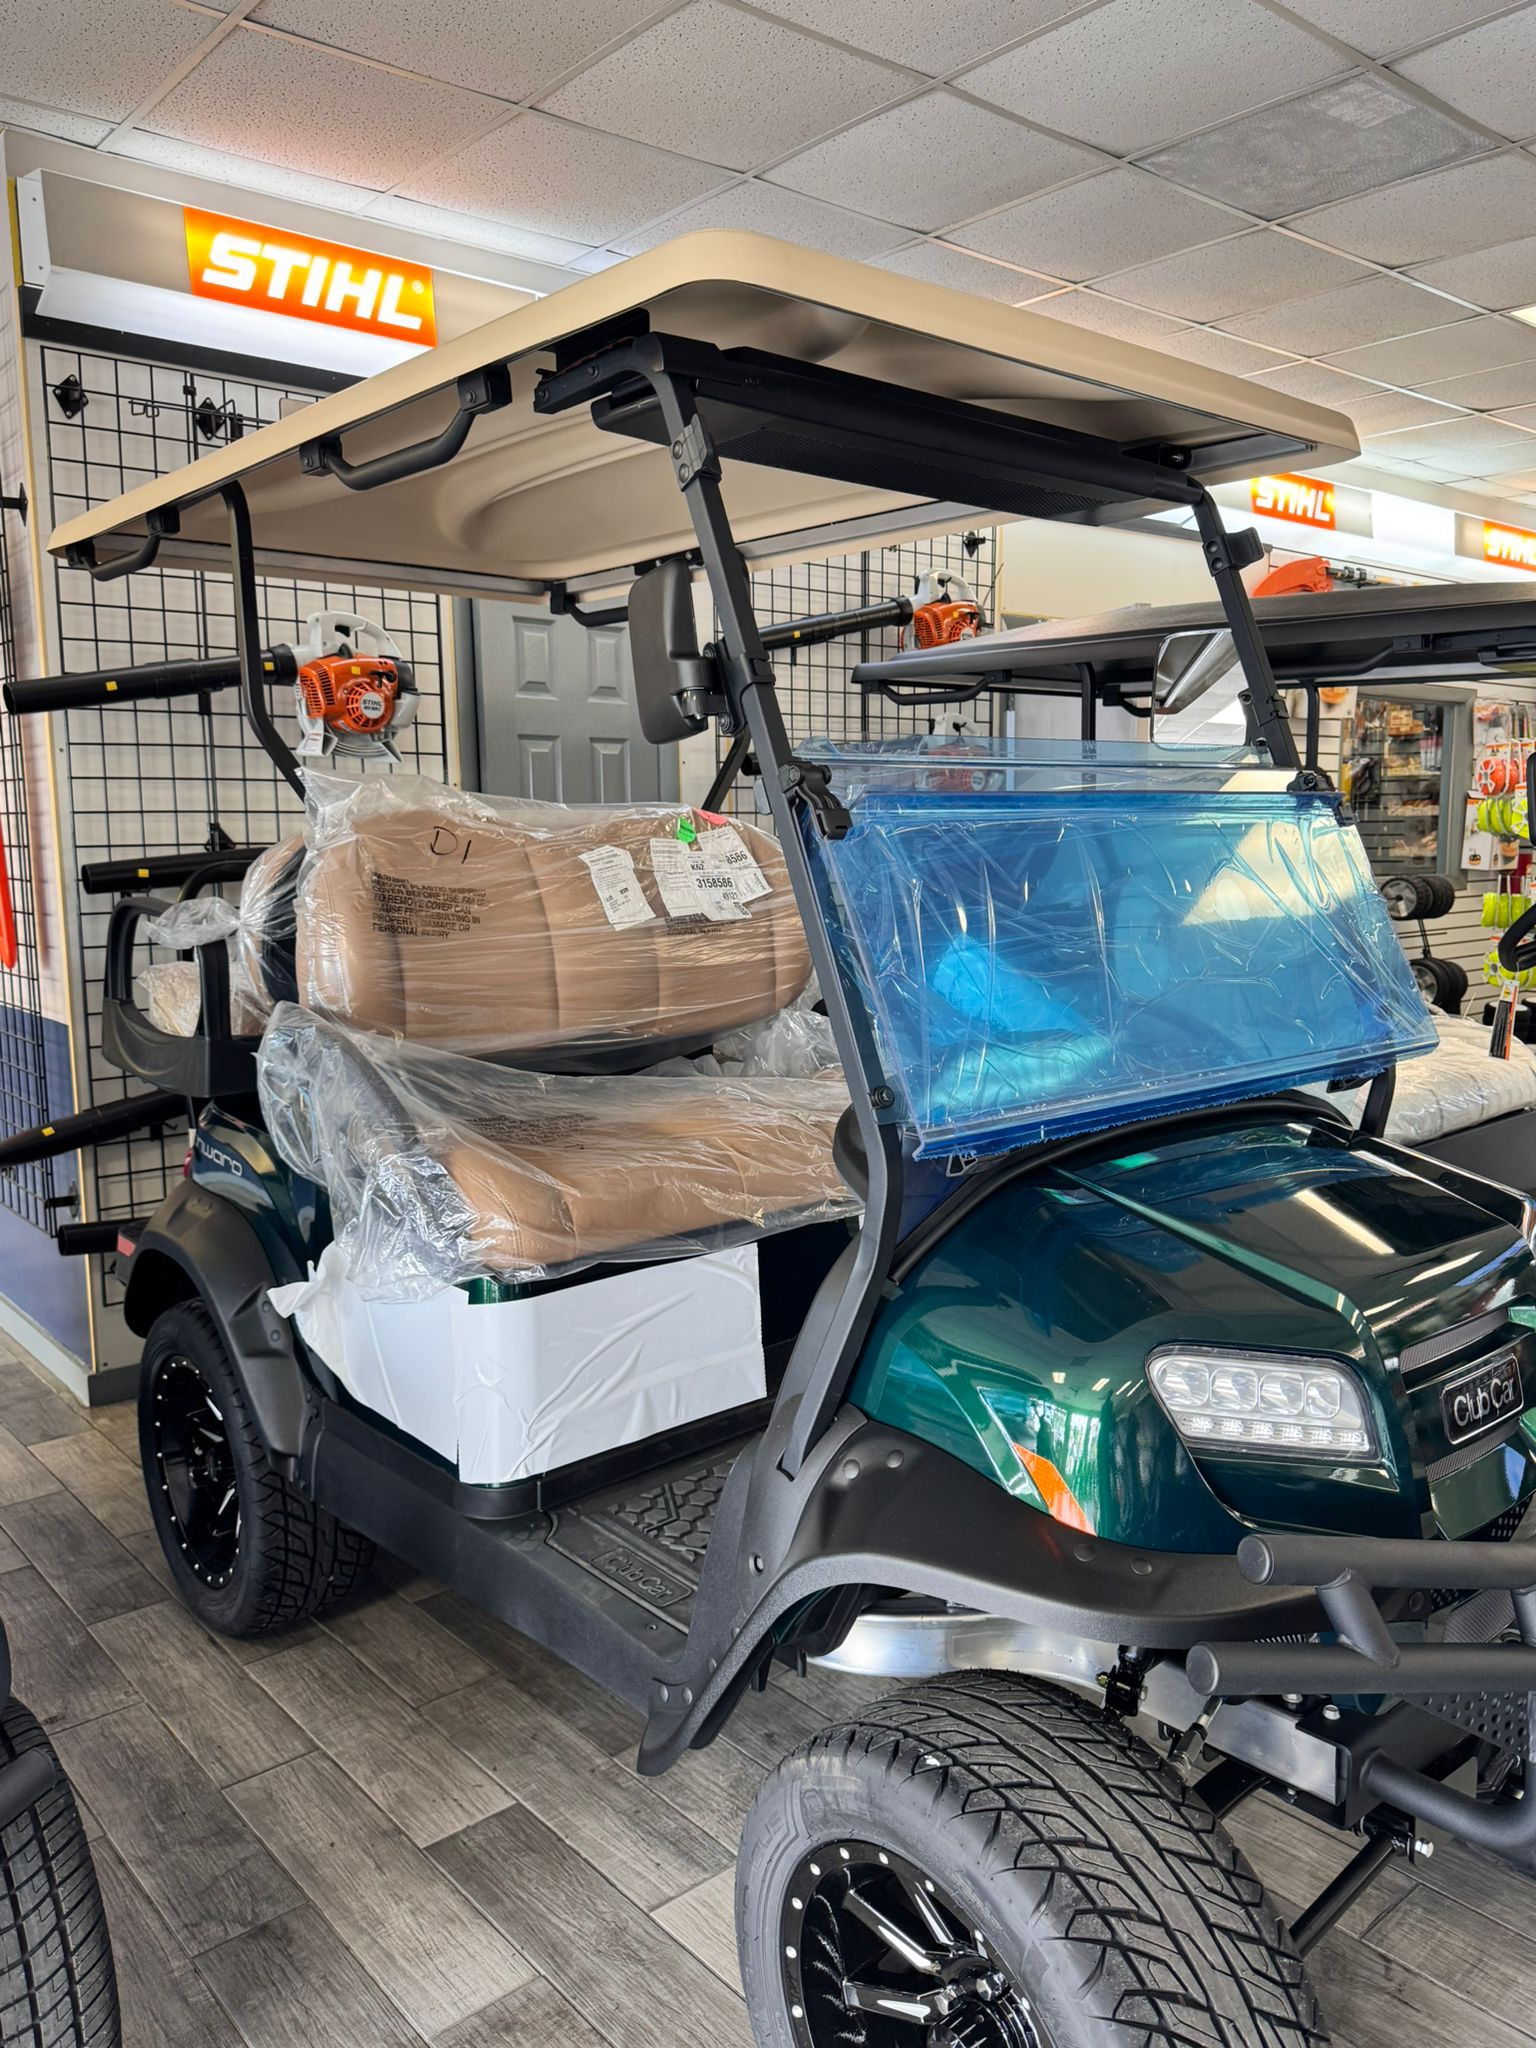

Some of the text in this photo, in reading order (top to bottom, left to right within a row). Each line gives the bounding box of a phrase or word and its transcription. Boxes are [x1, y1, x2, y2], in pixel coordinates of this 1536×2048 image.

[202, 232, 423, 330] STIHL
[1256, 476, 1330, 522] STIHL
[696, 877, 733, 889] 3158586
[377, 902, 403, 915] AUSE
[425, 900, 452, 911] COVER
[459, 923, 470, 932] OR
[1454, 1377, 1515, 1427] Club Car
[638, 1577, 673, 1599] Car
